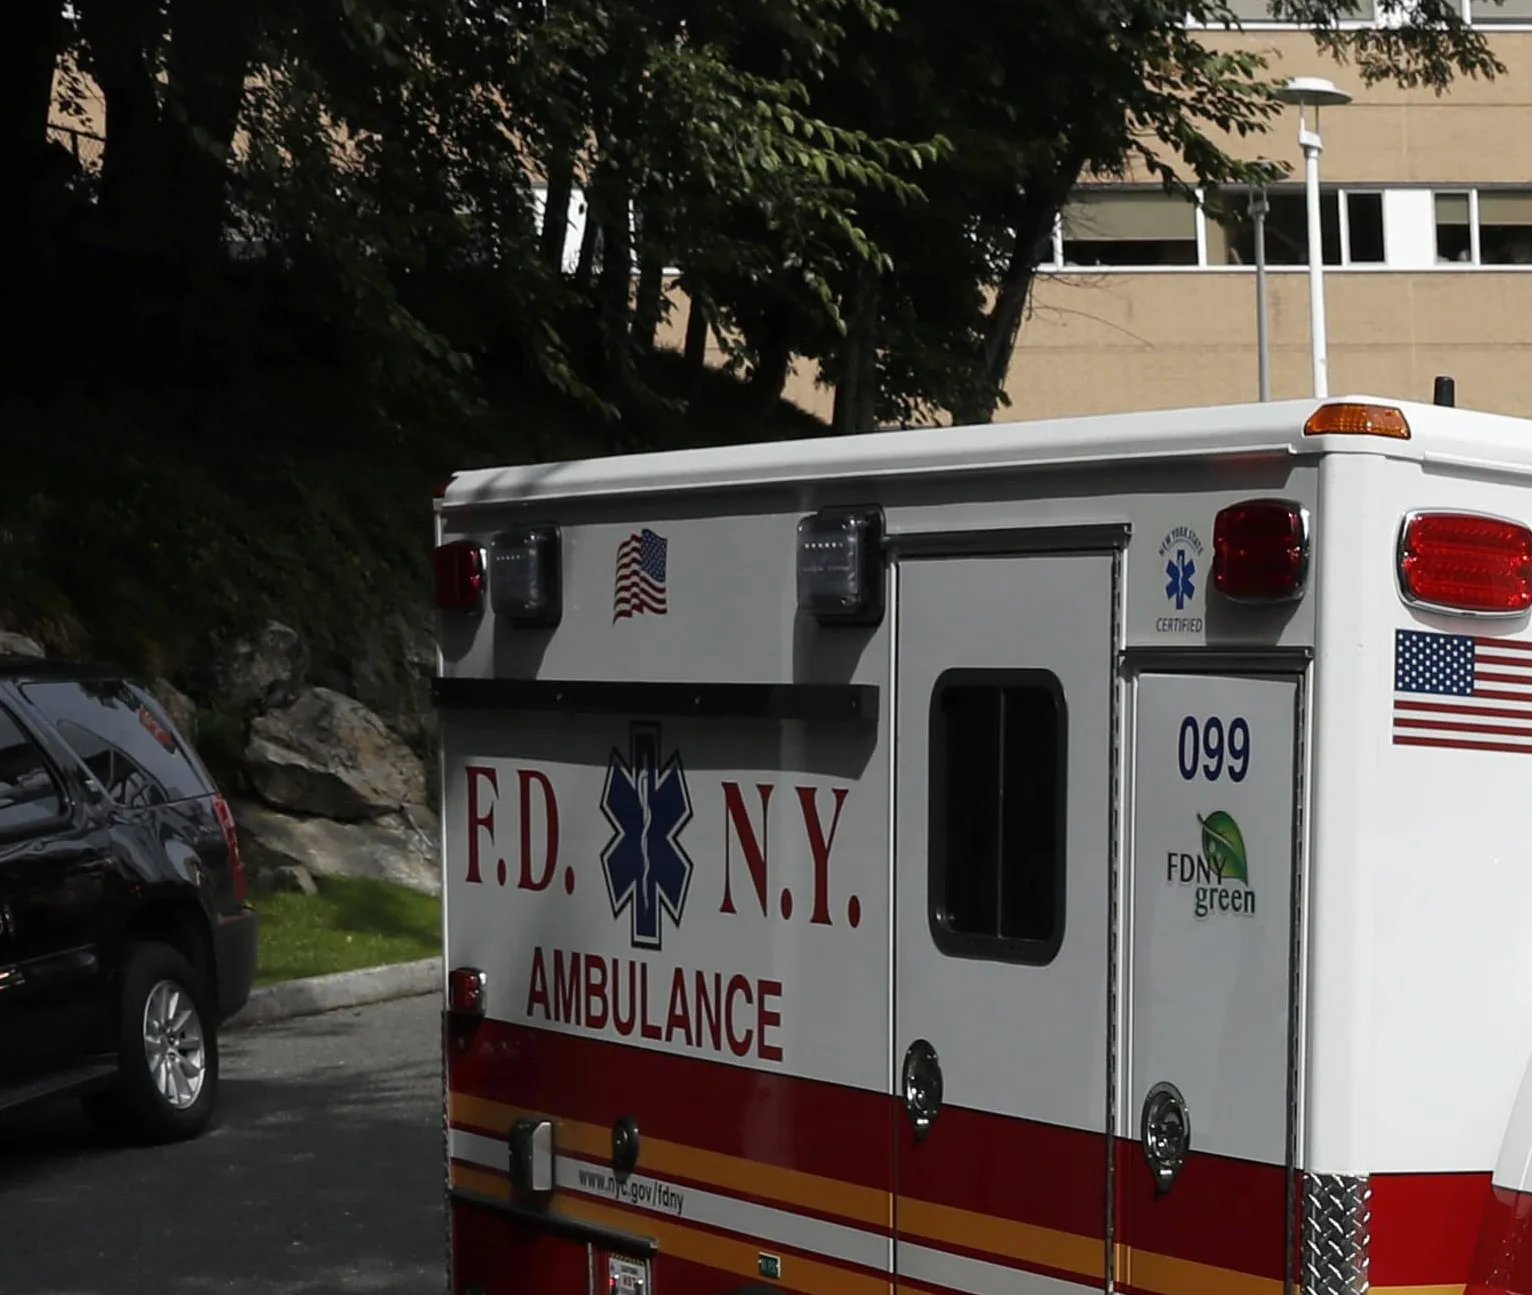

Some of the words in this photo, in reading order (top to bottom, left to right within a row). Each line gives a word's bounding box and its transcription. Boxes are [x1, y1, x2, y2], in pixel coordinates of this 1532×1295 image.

[1158, 535, 1172, 557] NEW
[1172, 526, 1188, 540] YORK
[1156, 617, 1203, 633] CERTIFIED
[1178, 715, 1251, 784] 099
[464, 766, 576, 897] F.D.
[719, 780, 862, 929] N.Y.
[1167, 852, 1229, 885] FDNY
[1194, 884, 1256, 918] green
[526, 946, 784, 1063] AMBULANCE
[578, 1168, 684, 1216] www.nyc.gov/fdny
